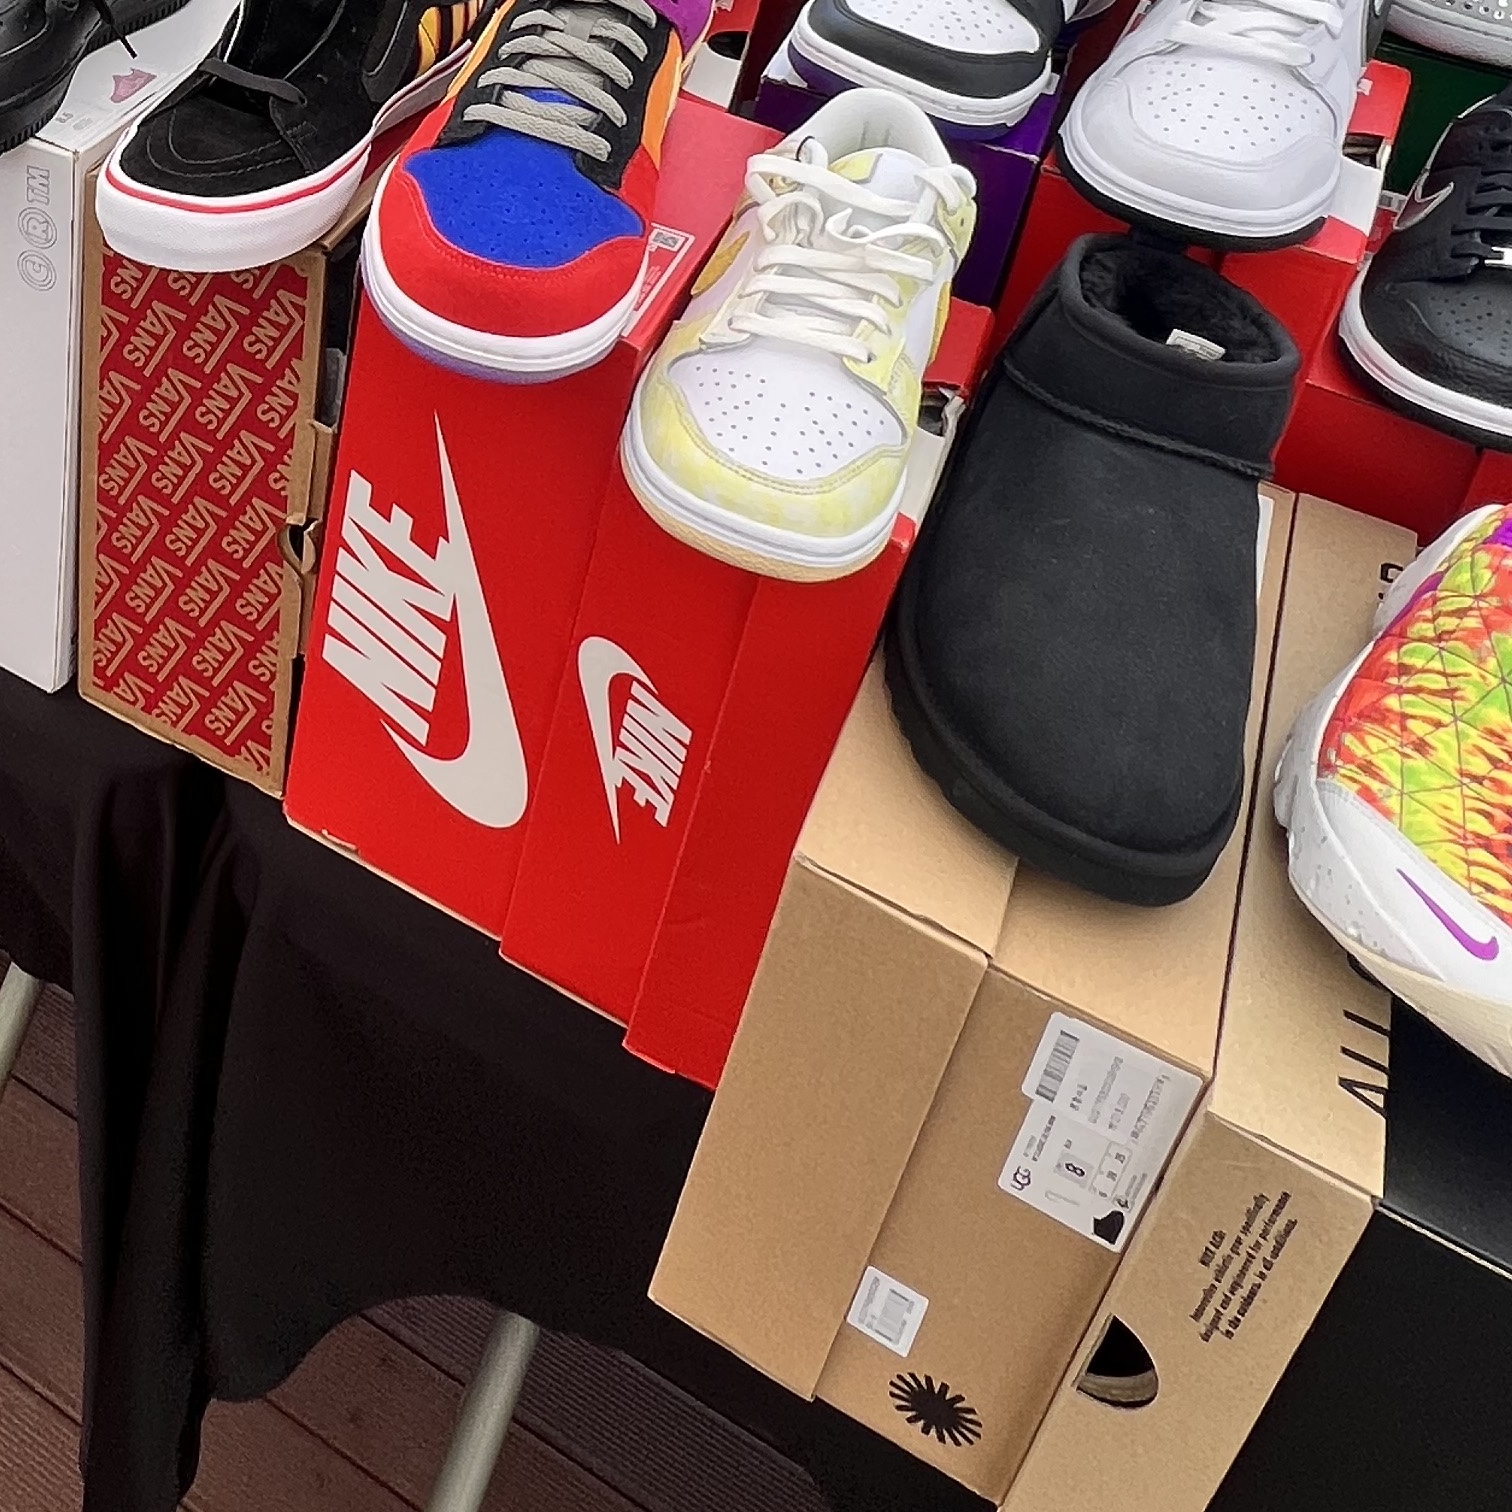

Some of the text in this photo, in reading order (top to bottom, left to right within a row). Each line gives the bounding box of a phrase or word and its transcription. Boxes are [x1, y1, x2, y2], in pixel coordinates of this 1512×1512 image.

[123, 300, 187, 378] VANS
[183, 294, 250, 373] VANS
[243, 289, 306, 370] VANS
[139, 367, 202, 443] VANS
[195, 363, 264, 440] VANS
[99, 435, 158, 505] VANS
[151, 431, 214, 505] VANS
[208, 429, 276, 506] VANS
[111, 494, 170, 564] VANS
[165, 495, 228, 567] VANS
[221, 496, 287, 569] VANS
[125, 555, 183, 625] VANS
[178, 558, 241, 627] VANS
[322, 469, 456, 747] NIKE
[137, 616, 196, 682] VANS
[192, 620, 255, 687] VANS
[205, 680, 267, 746] VANS
[613, 680, 693, 828] NIKE
[1010, 1165, 1031, 1191] UGG
[1065, 1162, 1085, 1177] 8
